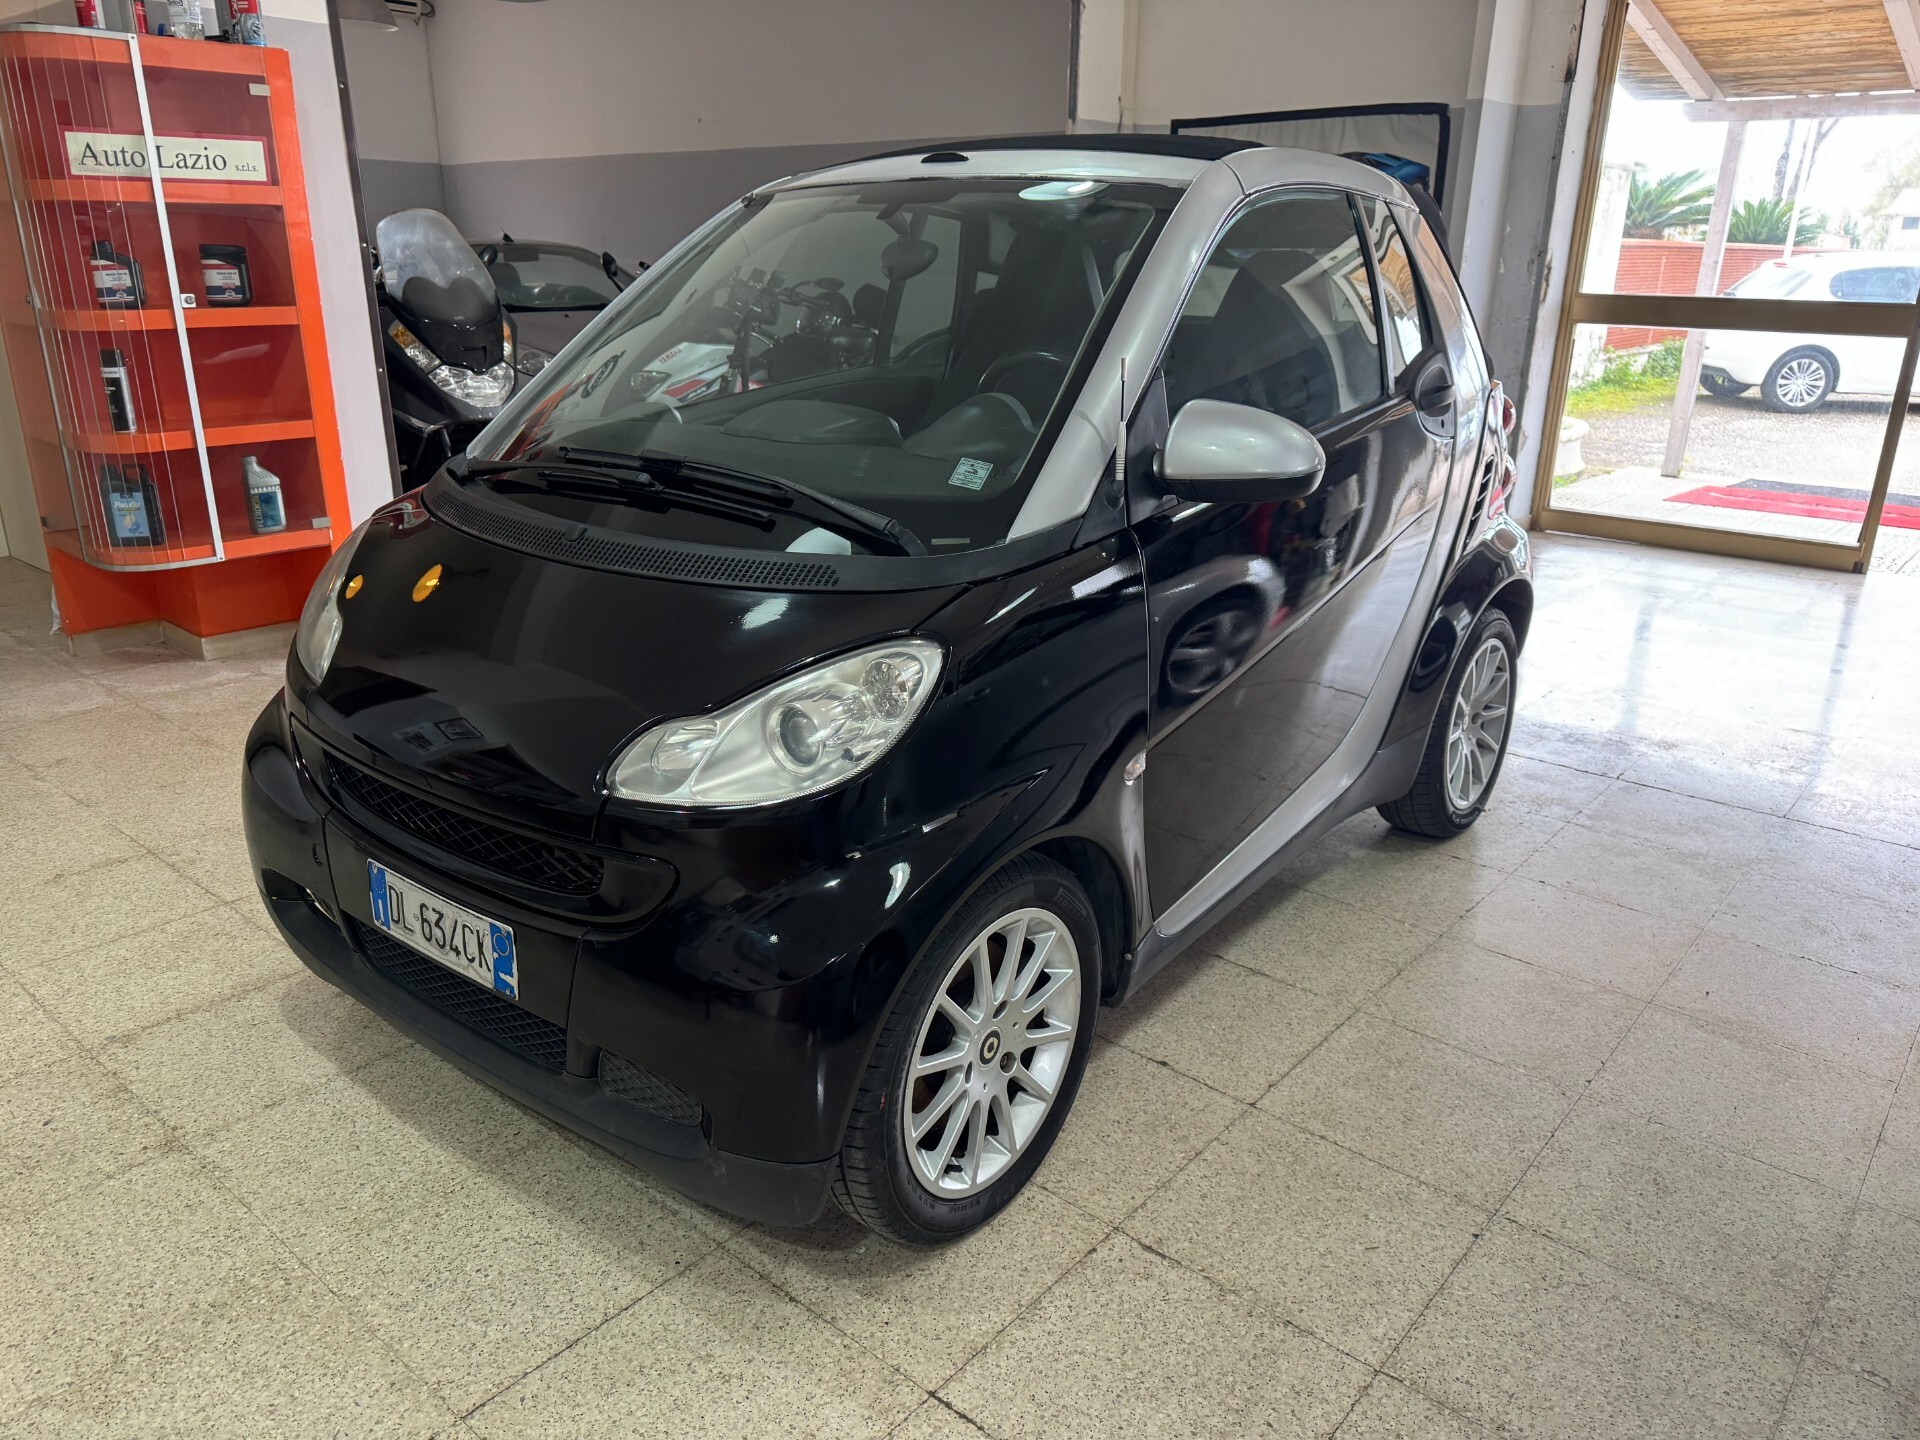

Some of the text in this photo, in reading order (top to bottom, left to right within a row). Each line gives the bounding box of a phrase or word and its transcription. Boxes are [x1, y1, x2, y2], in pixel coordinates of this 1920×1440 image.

[79, 142, 259, 173] Auto Lazio s.r.l.s.
[388, 884, 414, 933] DL
